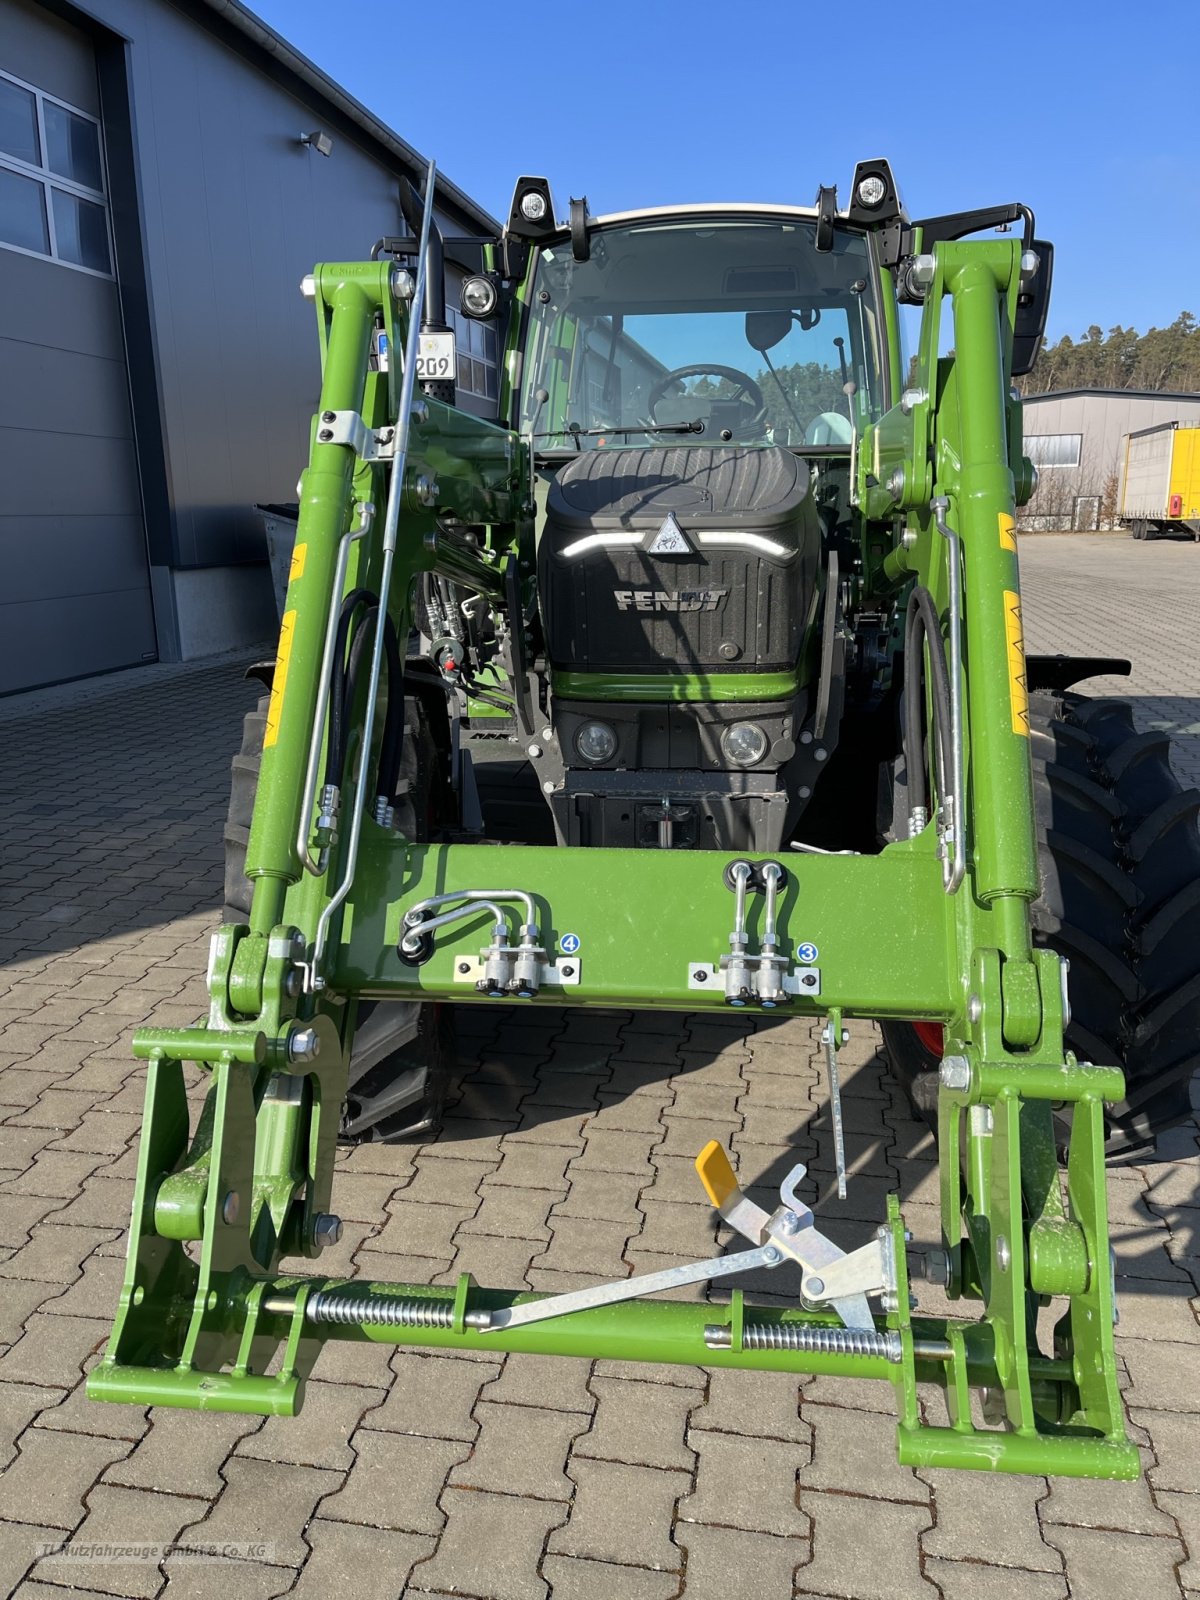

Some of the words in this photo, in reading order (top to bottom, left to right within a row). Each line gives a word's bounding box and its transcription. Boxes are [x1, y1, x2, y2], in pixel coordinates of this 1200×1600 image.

[613, 590, 727, 611] FENDT
[563, 936, 576, 951] 4
[801, 945, 814, 960] 3
